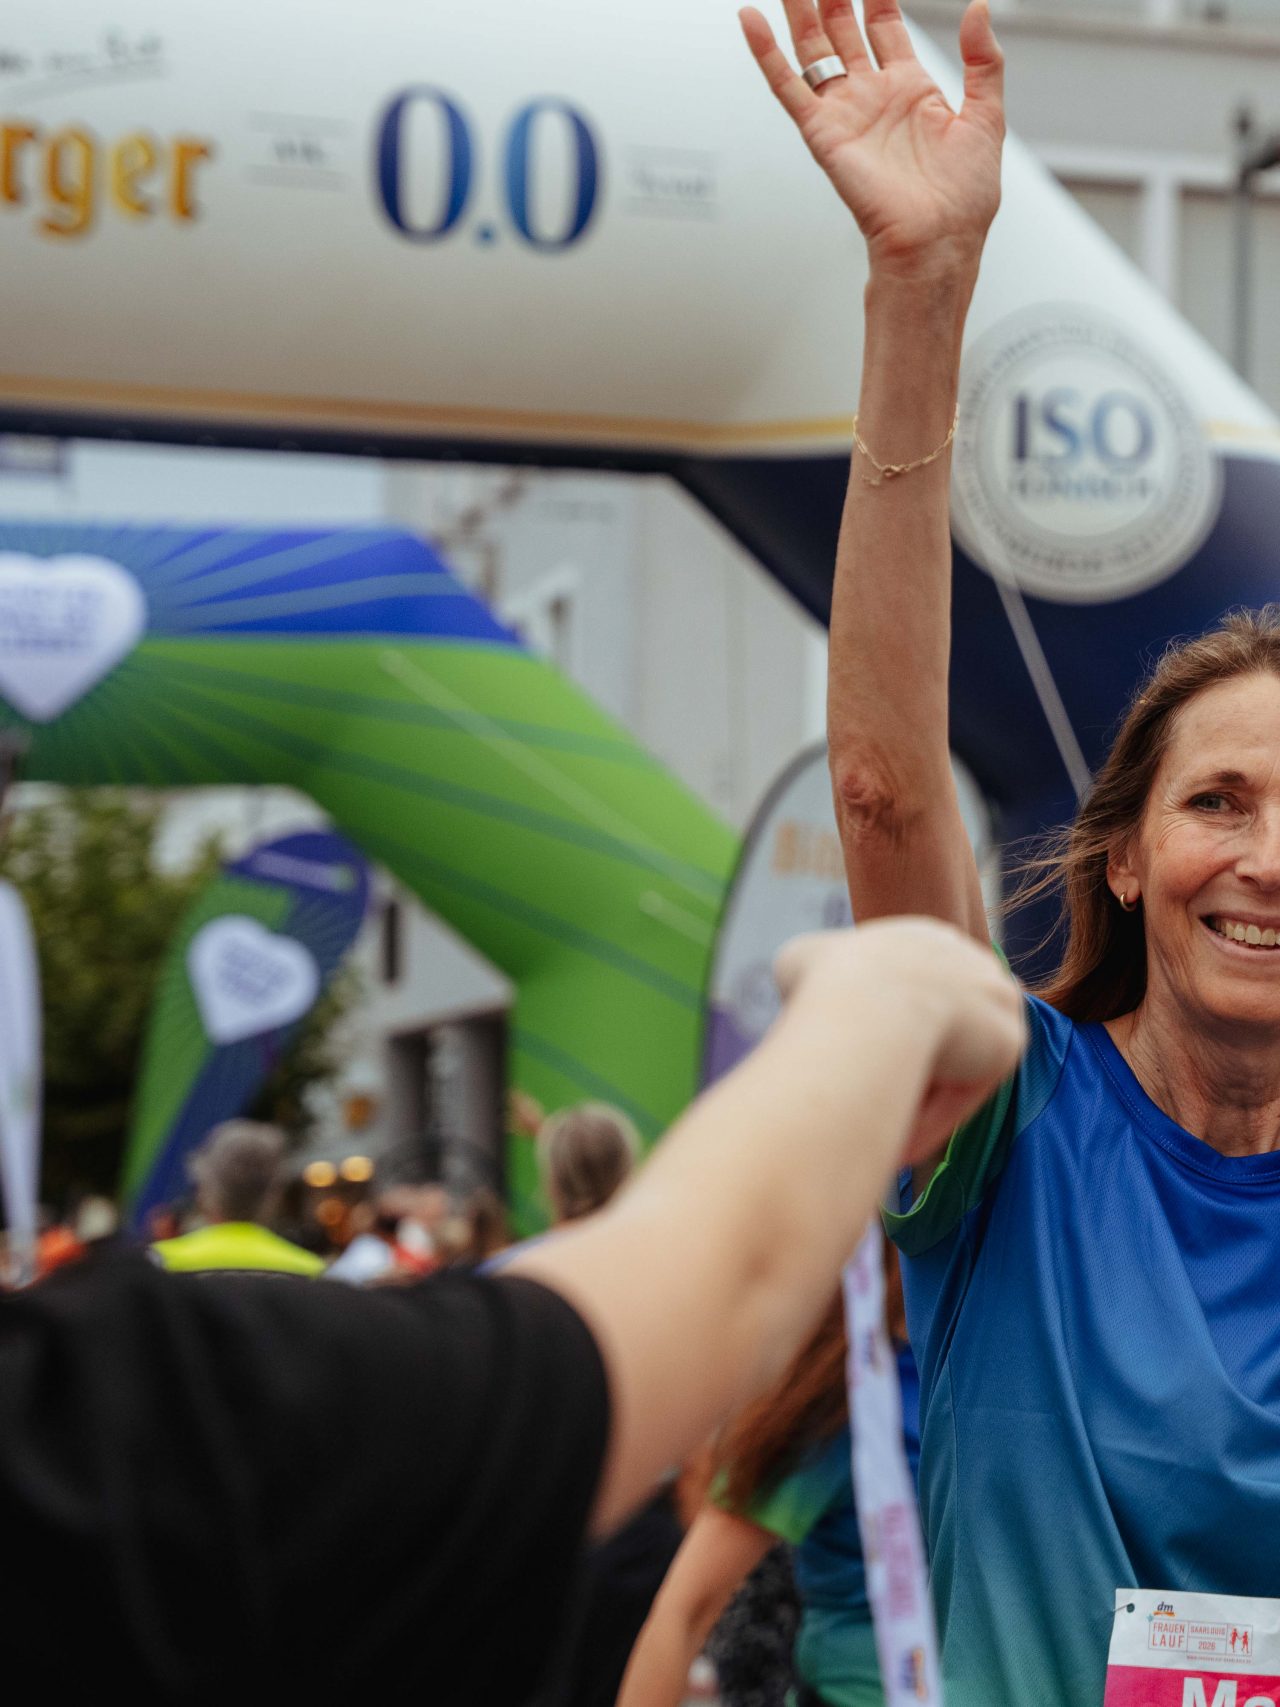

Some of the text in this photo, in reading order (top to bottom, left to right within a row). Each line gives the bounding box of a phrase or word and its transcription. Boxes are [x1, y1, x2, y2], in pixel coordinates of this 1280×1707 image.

[371, 83, 606, 254] 0.0
[1012, 388, 1155, 476] ISO
[1157, 1601, 1174, 1612] dm
[1153, 1622, 1185, 1633] FRAUEN
[1152, 1634, 1185, 1648] LAUF
